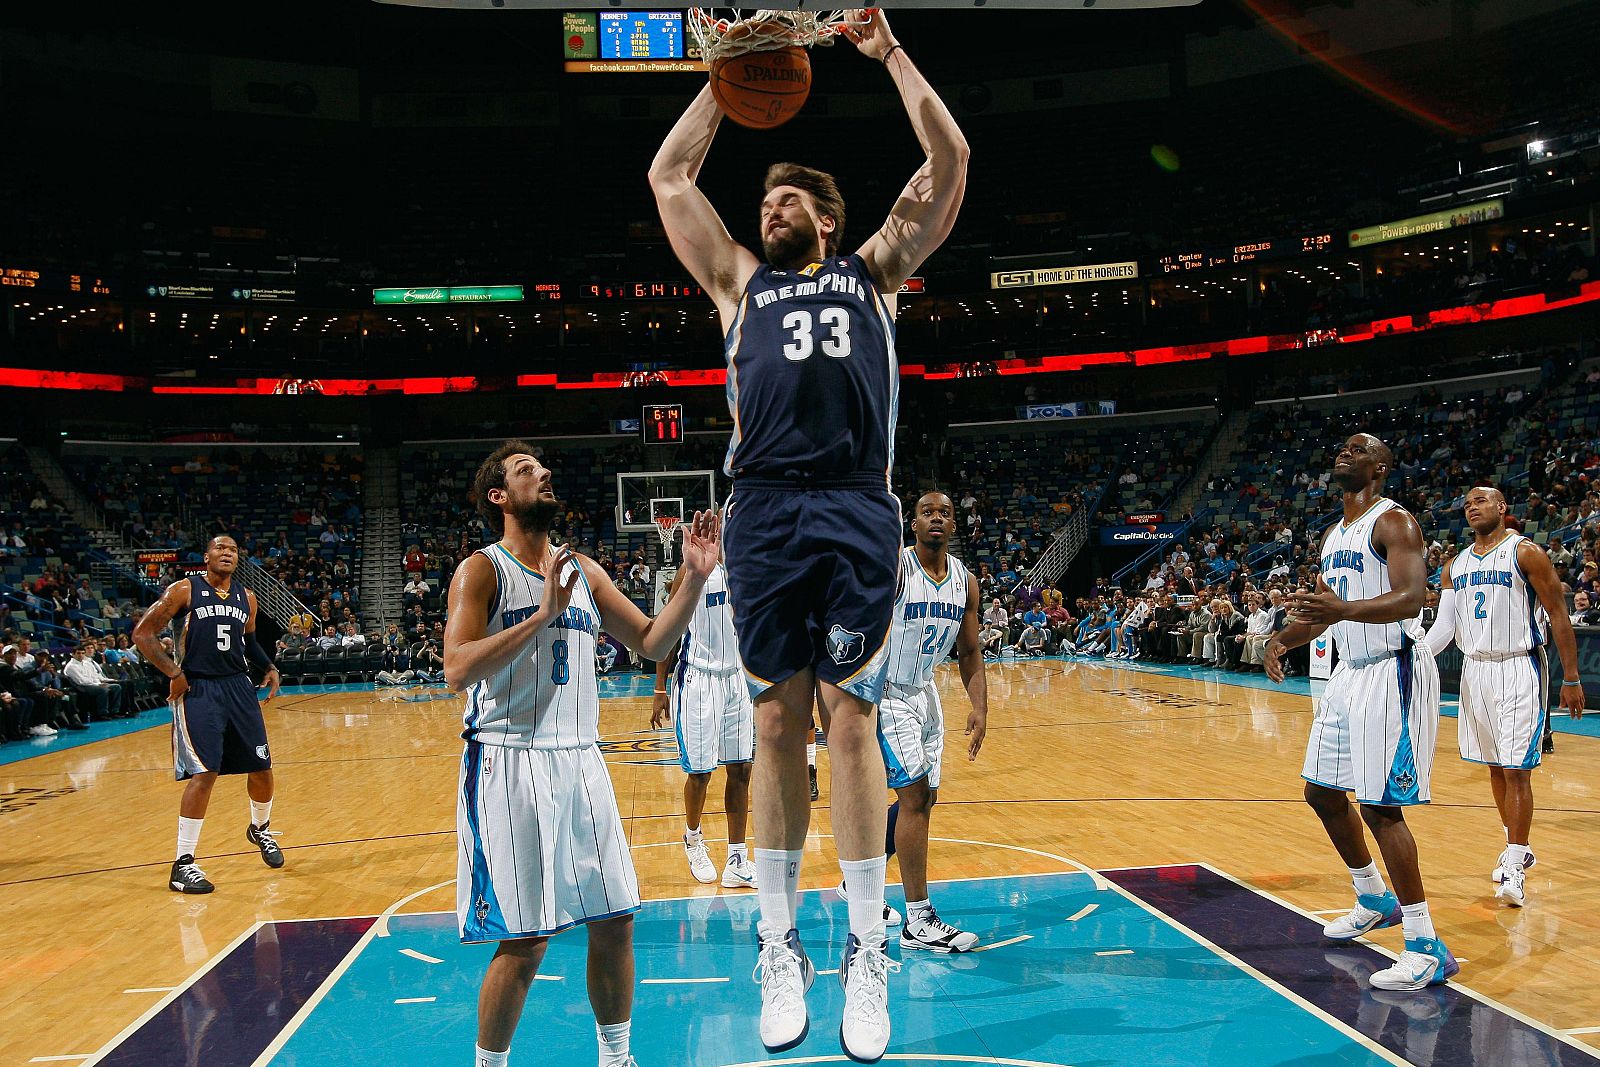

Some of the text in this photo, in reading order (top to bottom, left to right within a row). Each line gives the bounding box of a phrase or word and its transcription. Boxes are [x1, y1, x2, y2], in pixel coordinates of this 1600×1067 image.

[563, 17, 586, 25] Power
[571, 25, 595, 34] People
[590, 63, 694, 72] facebook.com/ThePowerToCare
[744, 64, 808, 85] SPALDING
[1382, 226, 1408, 239] POWER
[1416, 221, 1444, 234] PEOPLE
[1235, 243, 1271, 253] GRIZZLIES
[1302, 235, 1331, 246] 7:20
[1037, 272, 1063, 283] HOME
[1064, 270, 1075, 281] OF
[1076, 269, 1092, 280] THE
[1094, 265, 1134, 278] HORNETS
[591, 285, 599, 296] 9
[635, 284, 664, 297] 6:14
[754, 273, 865, 308] MEMPHIS
[782, 307, 851, 361] 33
[654, 410, 678, 420] 6:14
[657, 421, 677, 439] 11
[1332, 550, 1364, 573] ORLEANS
[1470, 570, 1513, 588] ORLEANS
[195, 604, 247, 624] MEMPHIS
[903, 602, 928, 620] NEW
[1474, 591, 1487, 619] 2
[216, 624, 231, 651] 5
[921, 625, 951, 654] 24
[551, 640, 569, 685] 8
